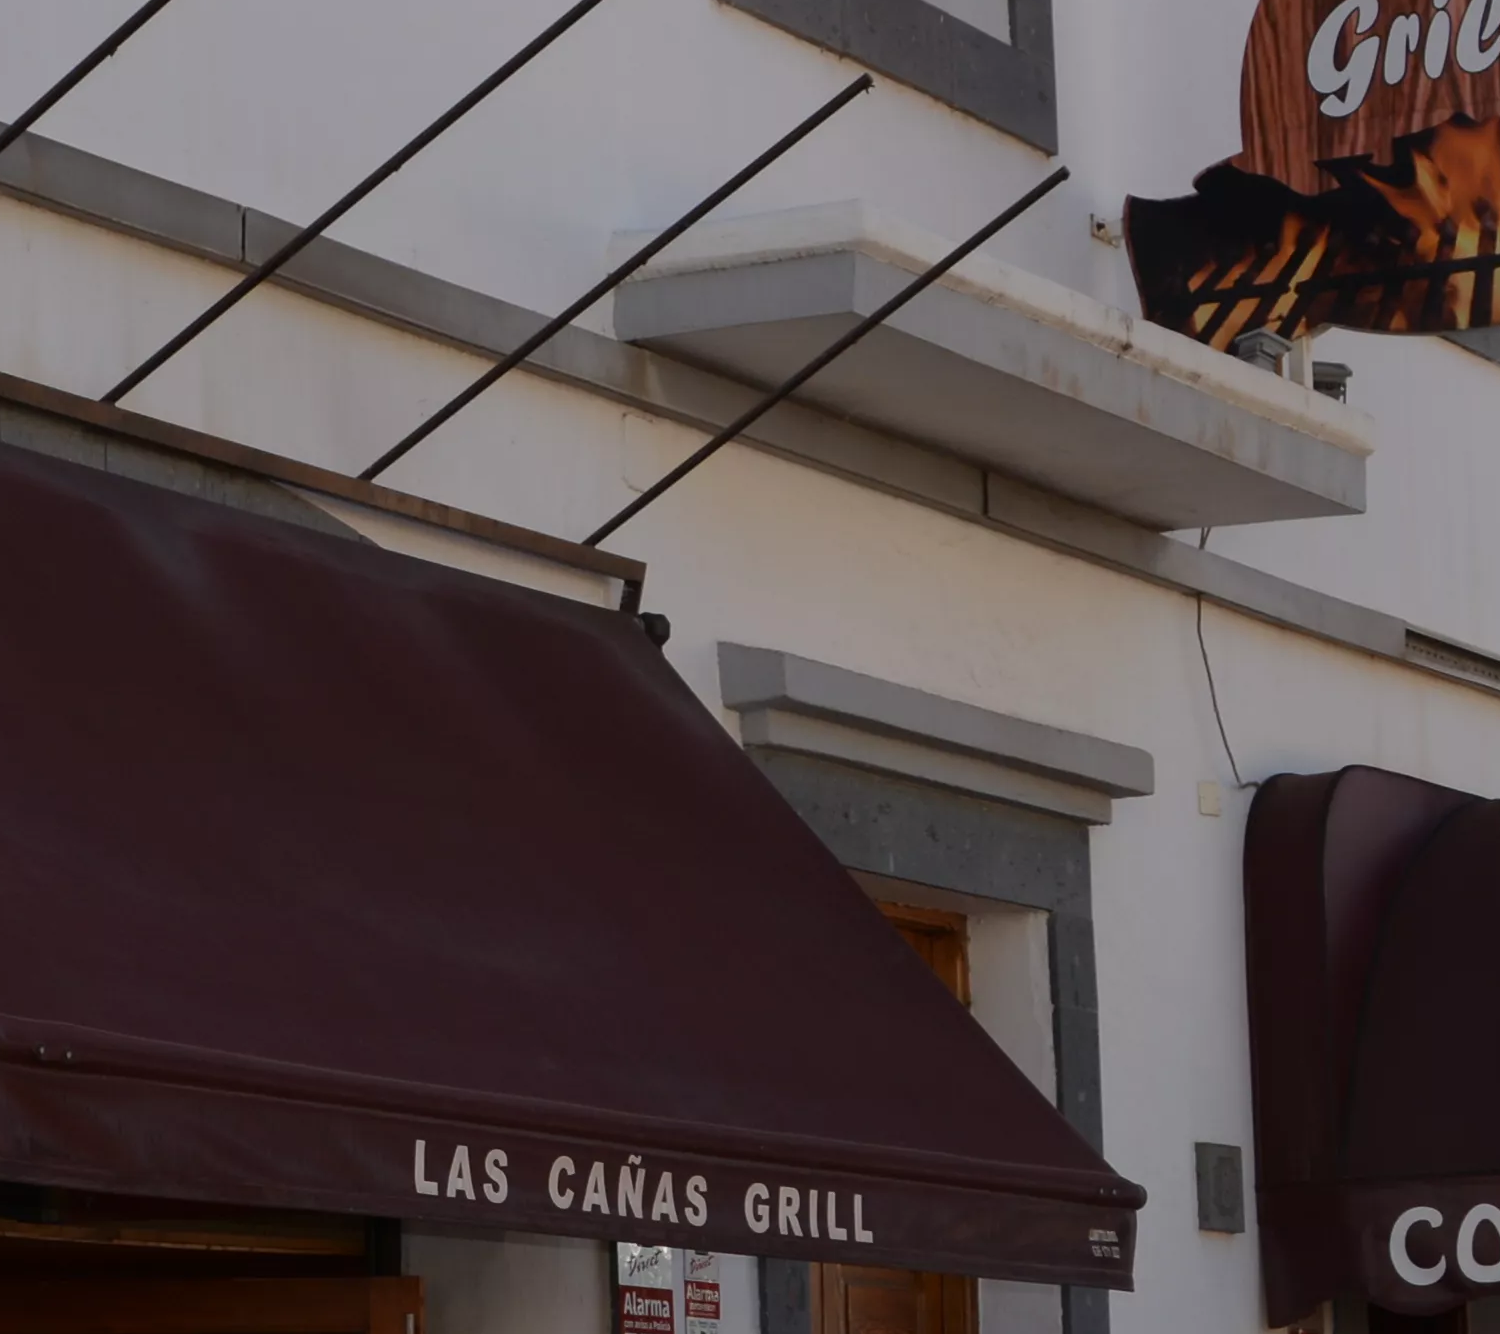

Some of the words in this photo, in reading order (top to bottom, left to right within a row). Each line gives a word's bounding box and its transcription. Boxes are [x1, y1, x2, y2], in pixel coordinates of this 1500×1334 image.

[413, 1139, 510, 1205] LAS
[547, 1154, 710, 1229] CAÑAS
[743, 1182, 875, 1245] GRILL
[623, 1291, 671, 1318] Alarma
[686, 1282, 720, 1303] Alarma
